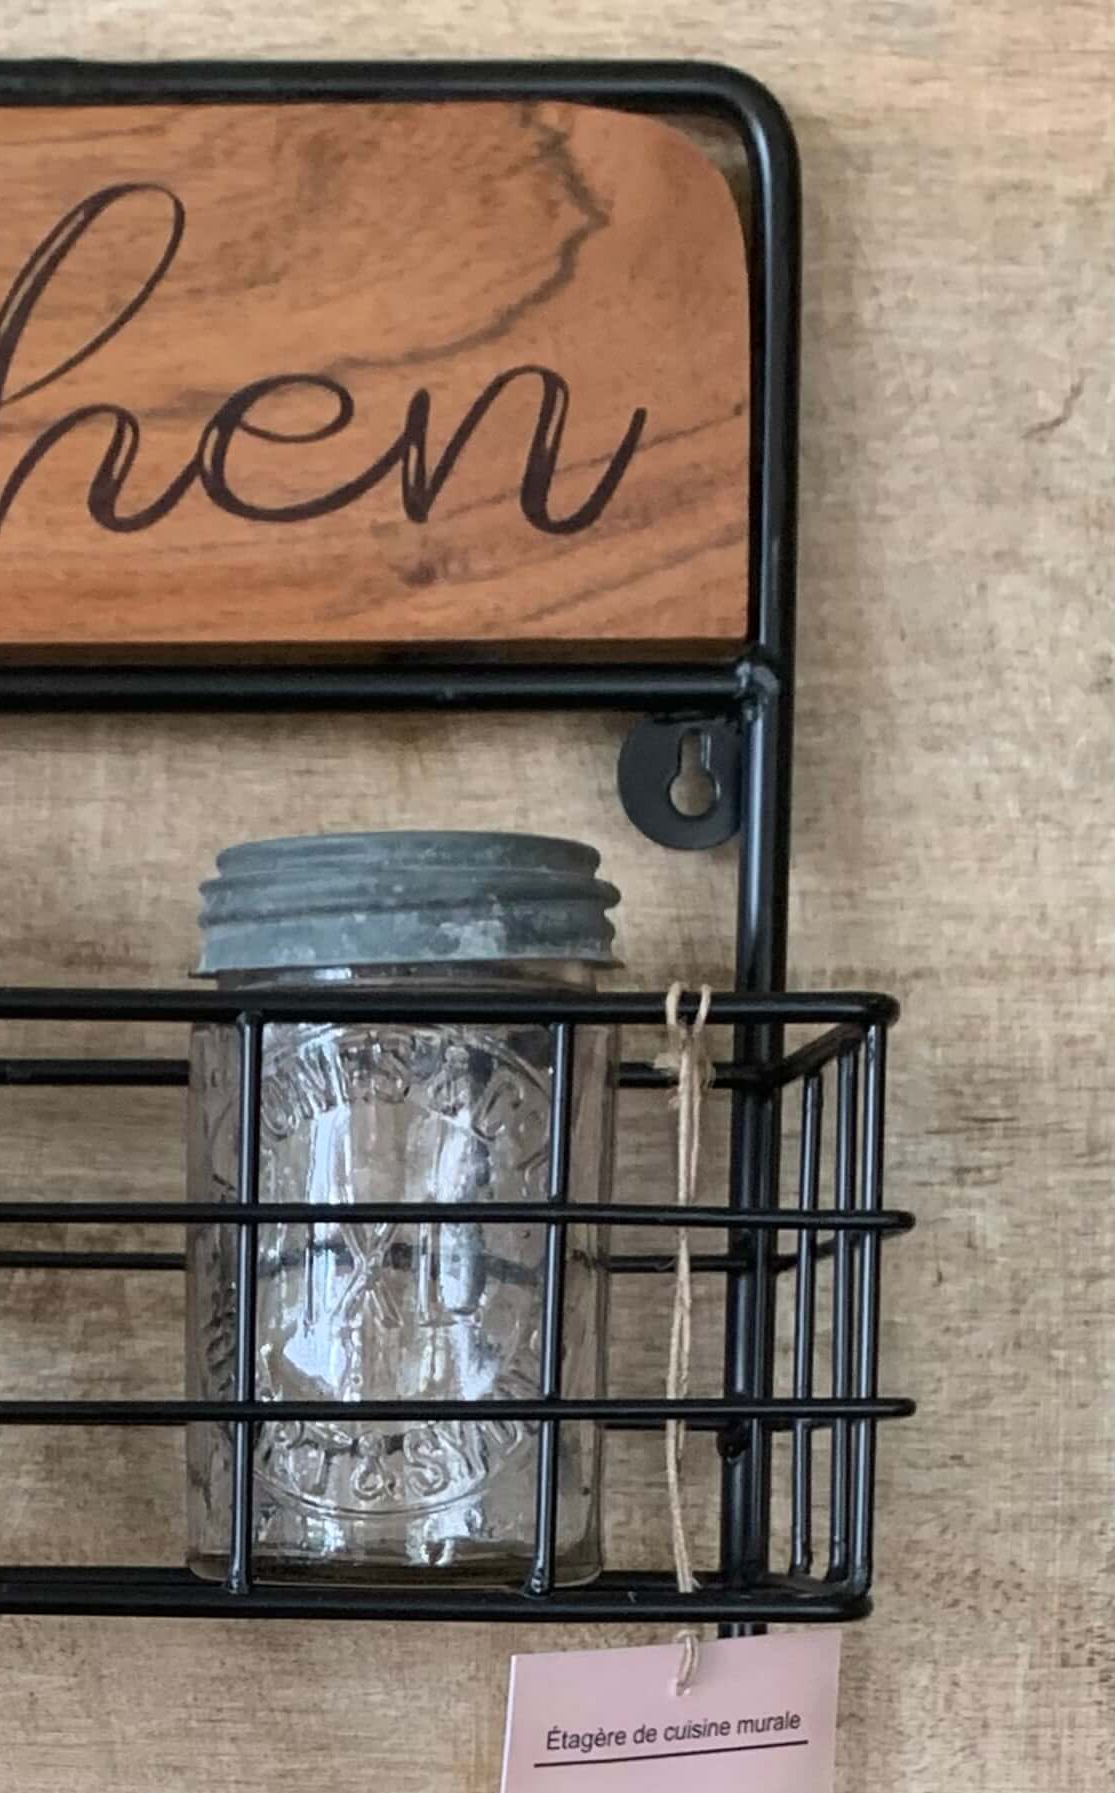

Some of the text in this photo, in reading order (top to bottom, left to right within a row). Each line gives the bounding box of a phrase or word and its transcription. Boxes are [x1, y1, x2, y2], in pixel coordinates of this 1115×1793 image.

[545, 1710, 802, 1754] Étagère de cuisine murale
